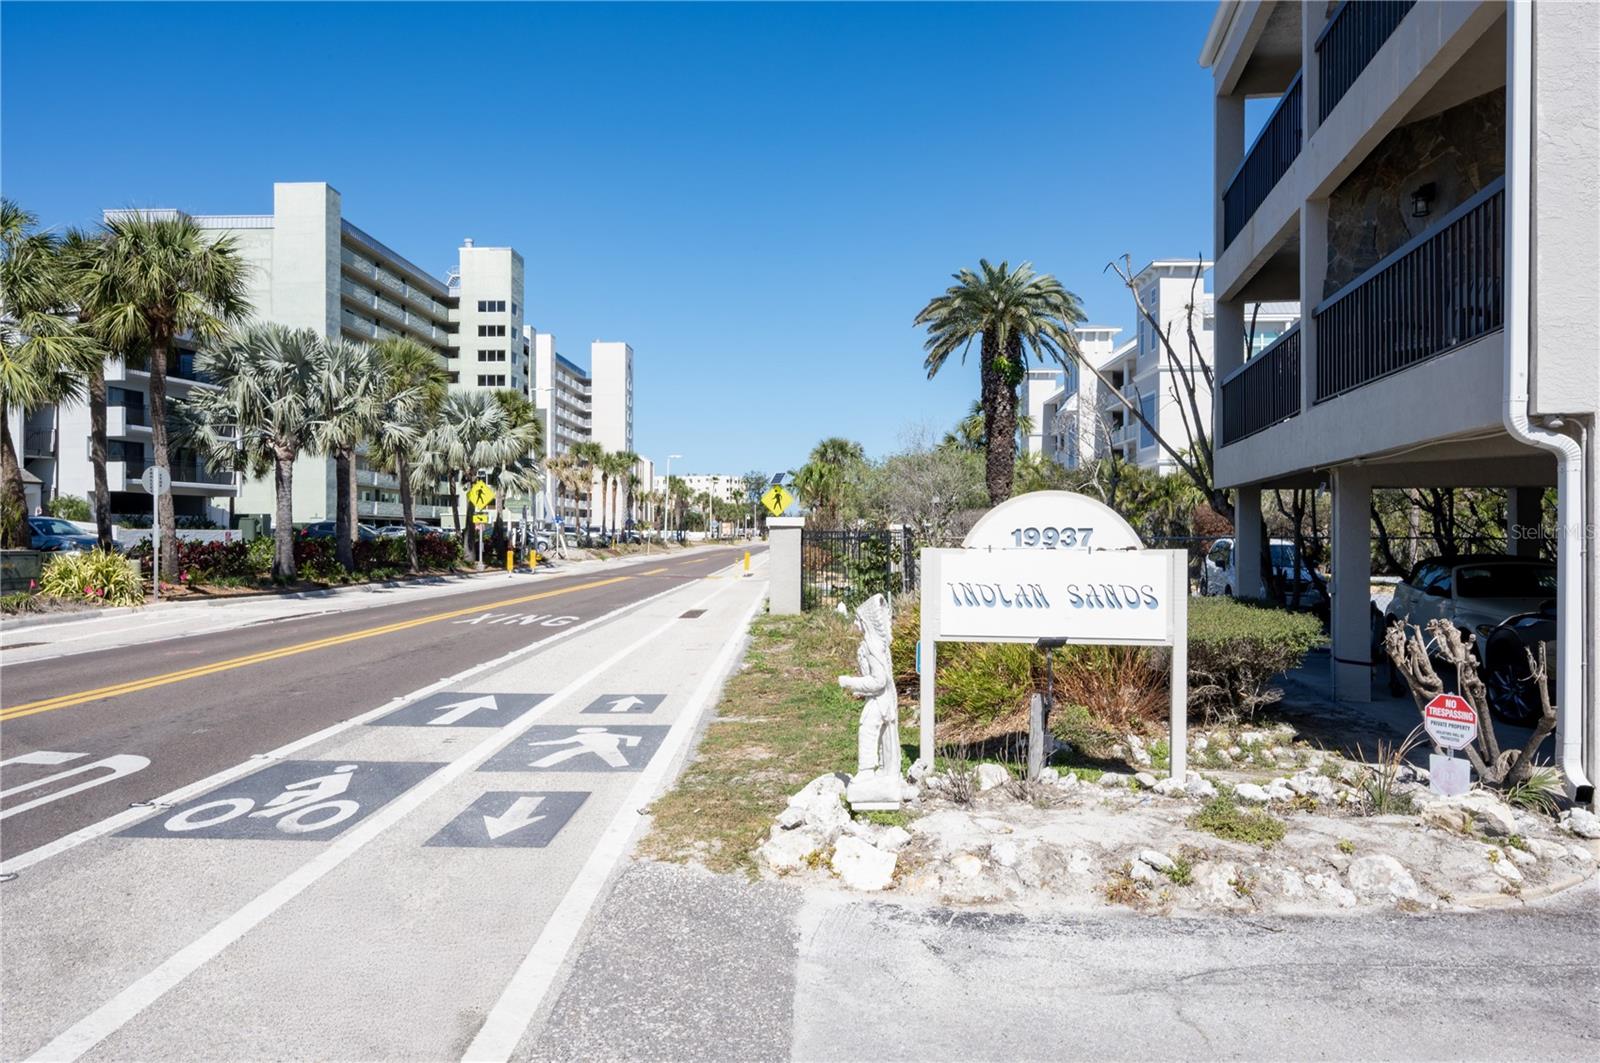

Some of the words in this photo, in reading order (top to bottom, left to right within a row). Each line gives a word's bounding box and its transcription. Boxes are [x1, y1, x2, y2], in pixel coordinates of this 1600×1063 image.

[1010, 527, 1094, 547] 19937
[1067, 583, 1159, 610] SANDS
[452, 613, 580, 627] XING
[1445, 699, 1457, 709] NO
[1429, 706, 1474, 721] TRESPASSING
[1430, 720, 1448, 728] PRIVATE
[1448, 722, 1471, 731] PROPERTY
